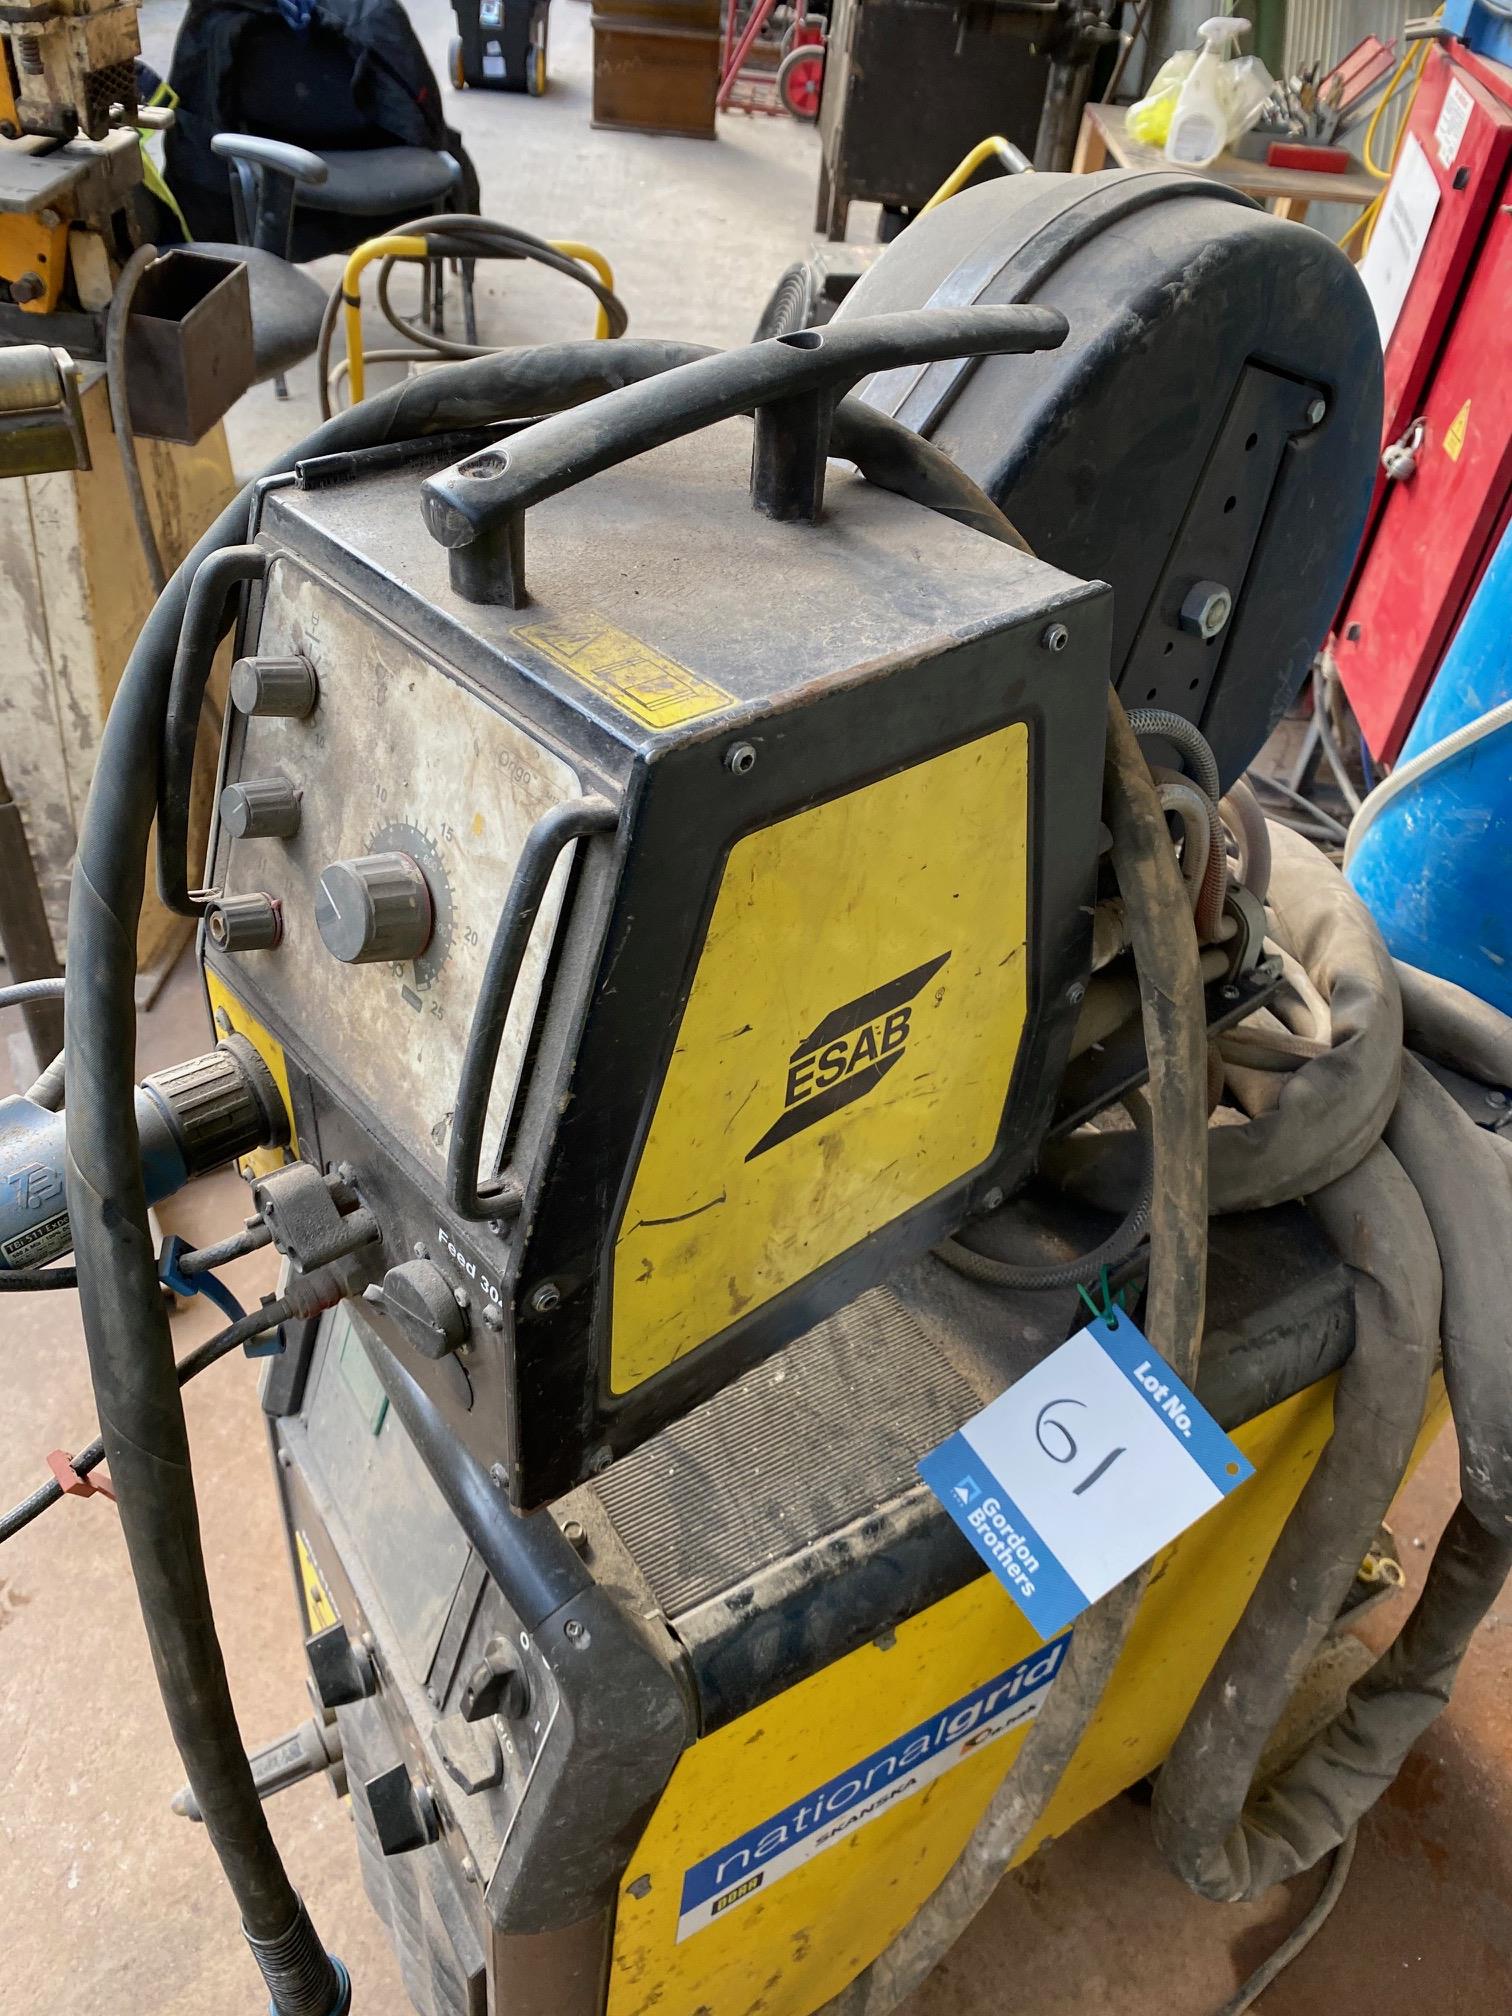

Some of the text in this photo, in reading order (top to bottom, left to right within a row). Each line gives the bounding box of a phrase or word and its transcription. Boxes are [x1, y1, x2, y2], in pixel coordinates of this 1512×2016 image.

[440, 822, 454, 842] 15
[463, 926, 478, 946] 20
[431, 1001, 444, 1021] 25
[784, 1006, 913, 1108] ESAB
[45, 1216, 70, 1232] Expe
[438, 1227, 476, 1279] Feed
[1132, 1360, 1194, 1438] Lot No.
[1035, 1398, 1127, 1496] 61
[967, 1507, 1037, 1598] Brothers
[980, 1497, 1041, 1573] Gordon
[714, 1643, 1064, 1885] nationalgrid
[815, 1778, 917, 1847] SKANSKA
